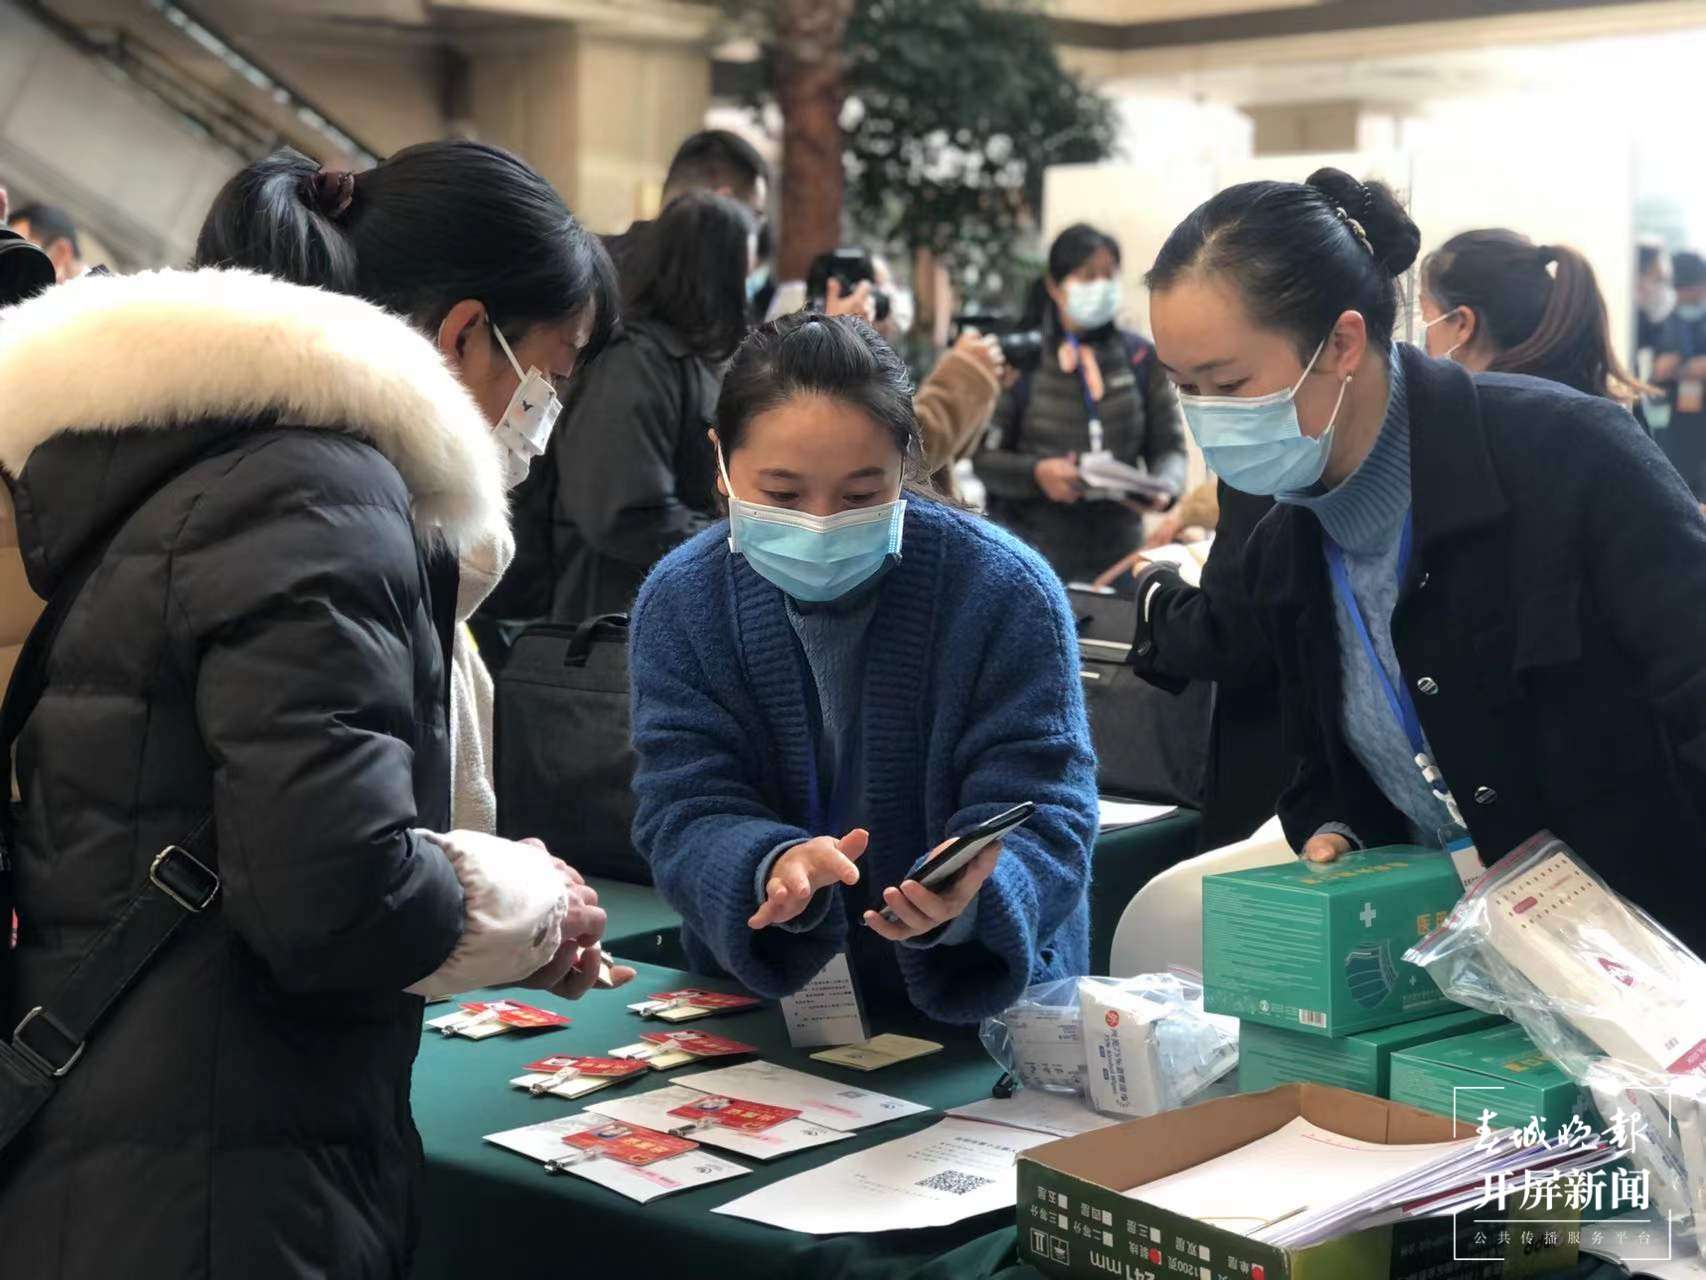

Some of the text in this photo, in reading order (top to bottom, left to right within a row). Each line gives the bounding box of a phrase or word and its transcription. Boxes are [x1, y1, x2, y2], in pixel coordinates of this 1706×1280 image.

[1030, 1204, 1058, 1225] 三等分
[1080, 1202, 1103, 1221] 四层
[1126, 1218, 1150, 1238] 三层
[1175, 1235, 1200, 1256] 双层
